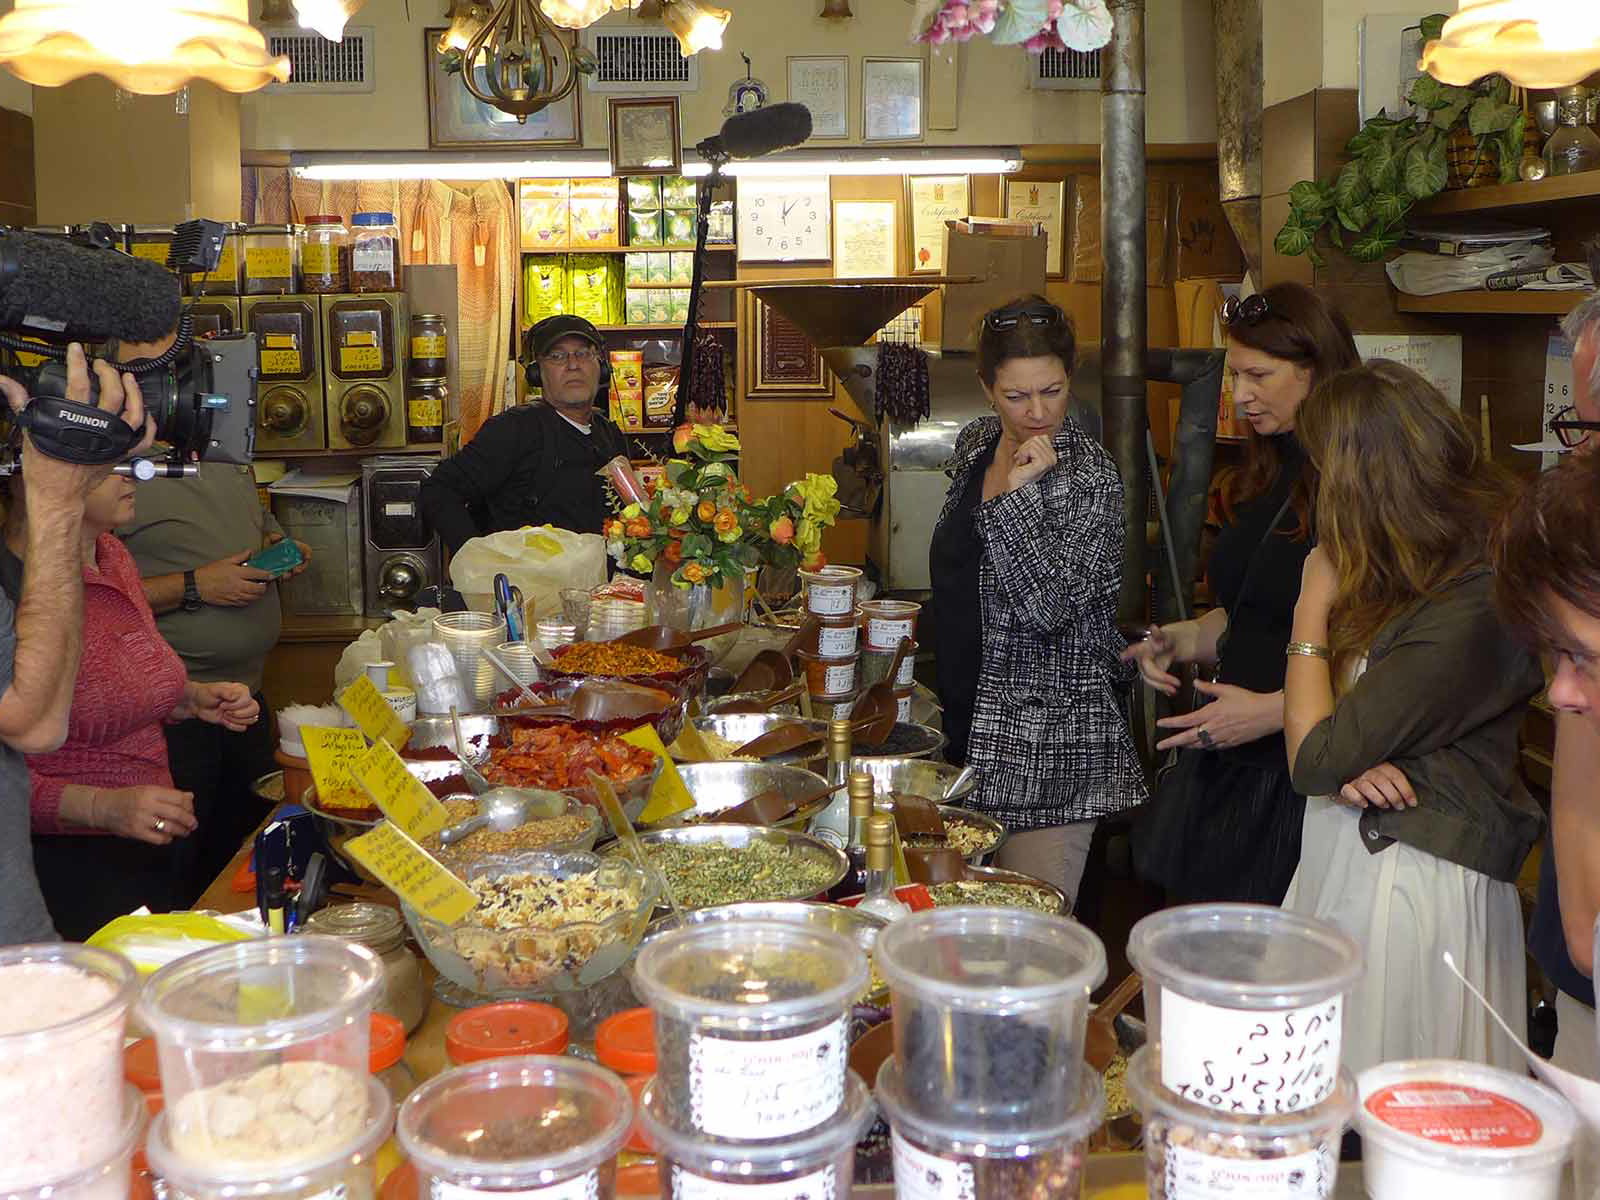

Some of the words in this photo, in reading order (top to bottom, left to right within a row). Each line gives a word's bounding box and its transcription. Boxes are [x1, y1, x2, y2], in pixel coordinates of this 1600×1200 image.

[754, 198, 765, 208] 10
[751, 212, 759, 222] 9
[809, 211, 817, 221] 3
[756, 226, 764, 236] 8
[766, 237, 773, 246] 7
[780, 240, 789, 250] 6
[795, 237, 803, 246] 5
[1548, 384, 1554, 394] 5
[1562, 385, 1568, 396] 6
[1545, 403, 1555, 414] 12
[58, 410, 109, 429] FUJINON
